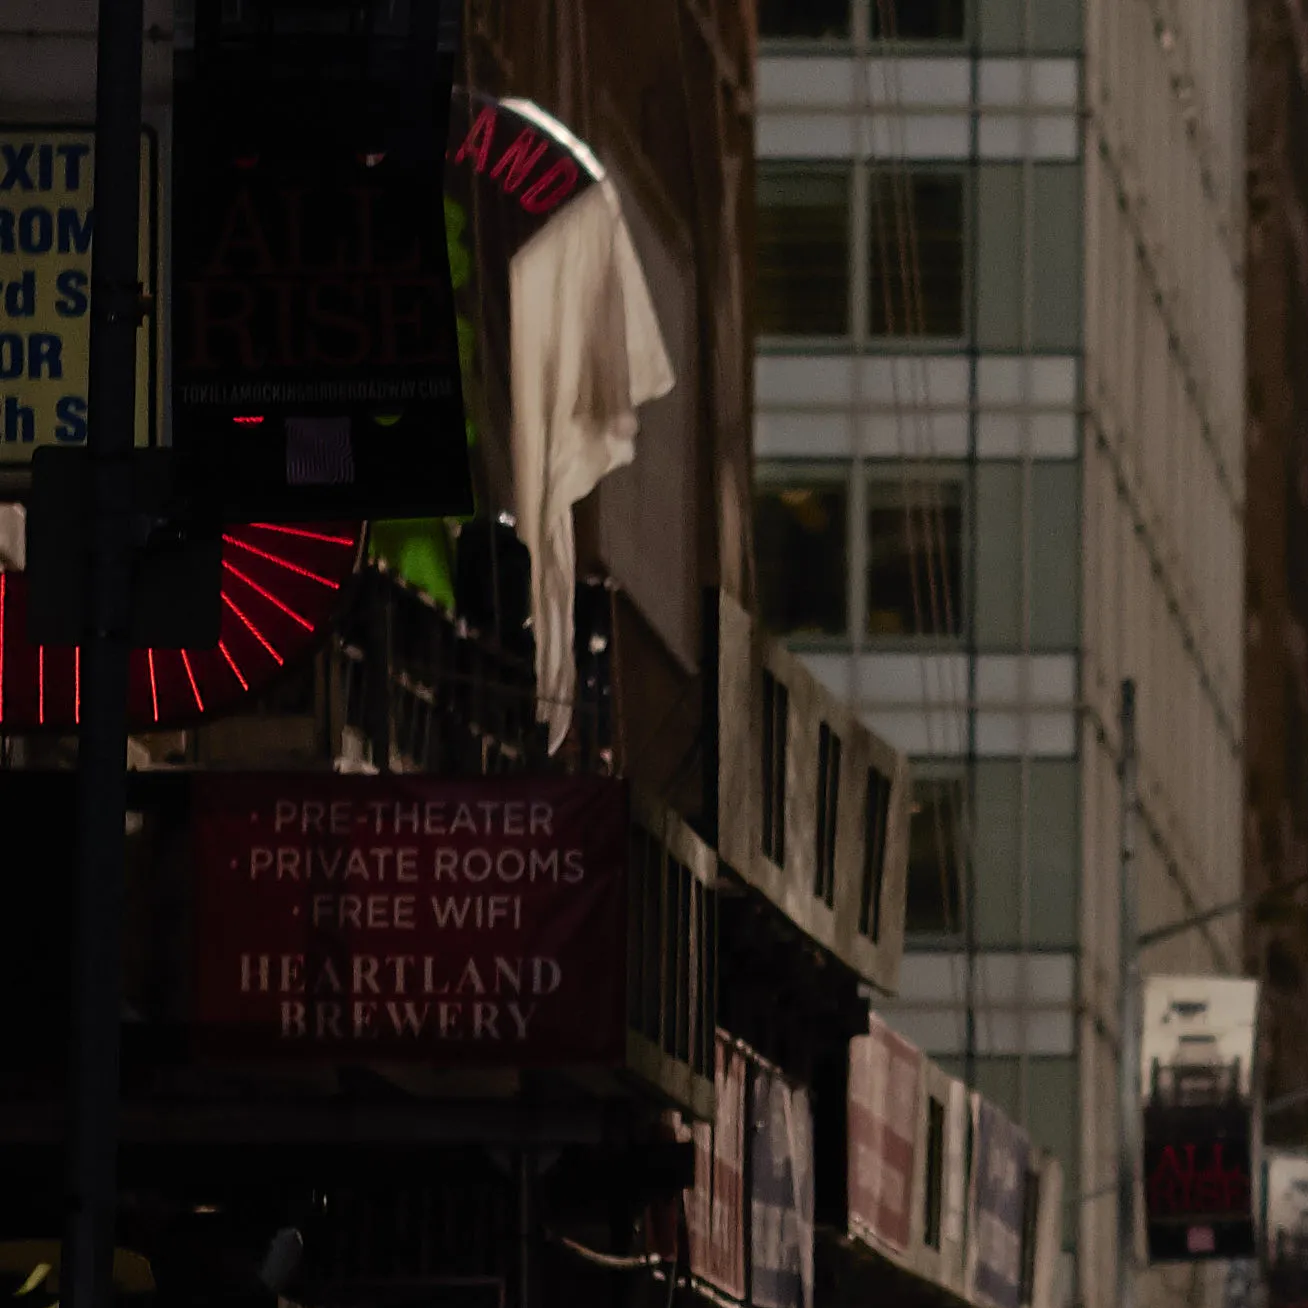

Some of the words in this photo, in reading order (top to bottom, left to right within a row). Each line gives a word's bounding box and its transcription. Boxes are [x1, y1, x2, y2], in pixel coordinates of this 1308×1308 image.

[446, 105, 579, 216] AND
[205, 186, 422, 272] ALL
[180, 274, 452, 370] RISE
[273, 800, 555, 836] PRE-THEATER
[249, 846, 418, 881] PRIVATE
[432, 848, 585, 882] ROOMS
[311, 895, 415, 929] FREE
[430, 896, 523, 930] WIFI
[240, 954, 562, 996] HEARTLAND
[279, 1001, 539, 1041] BREWERY
